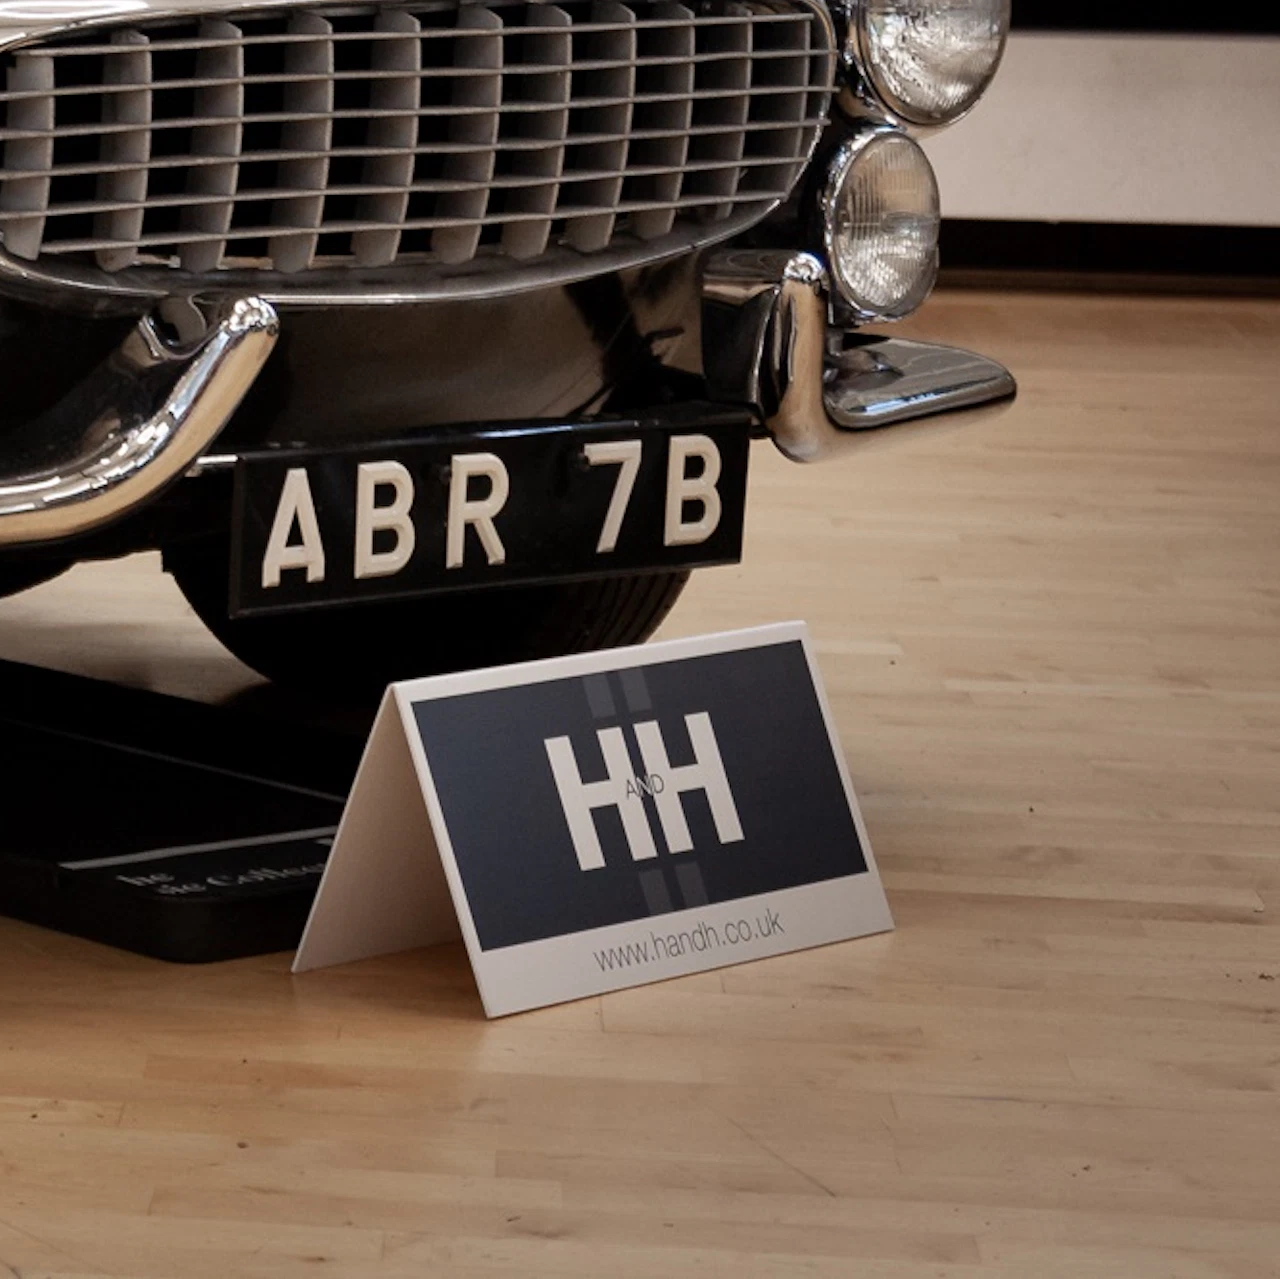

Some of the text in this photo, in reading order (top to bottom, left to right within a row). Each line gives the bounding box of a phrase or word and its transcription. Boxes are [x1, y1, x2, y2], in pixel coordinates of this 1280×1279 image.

[261, 433, 722, 588] ABR 7B
[593, 908, 785, 972] www.handh.co.uk
